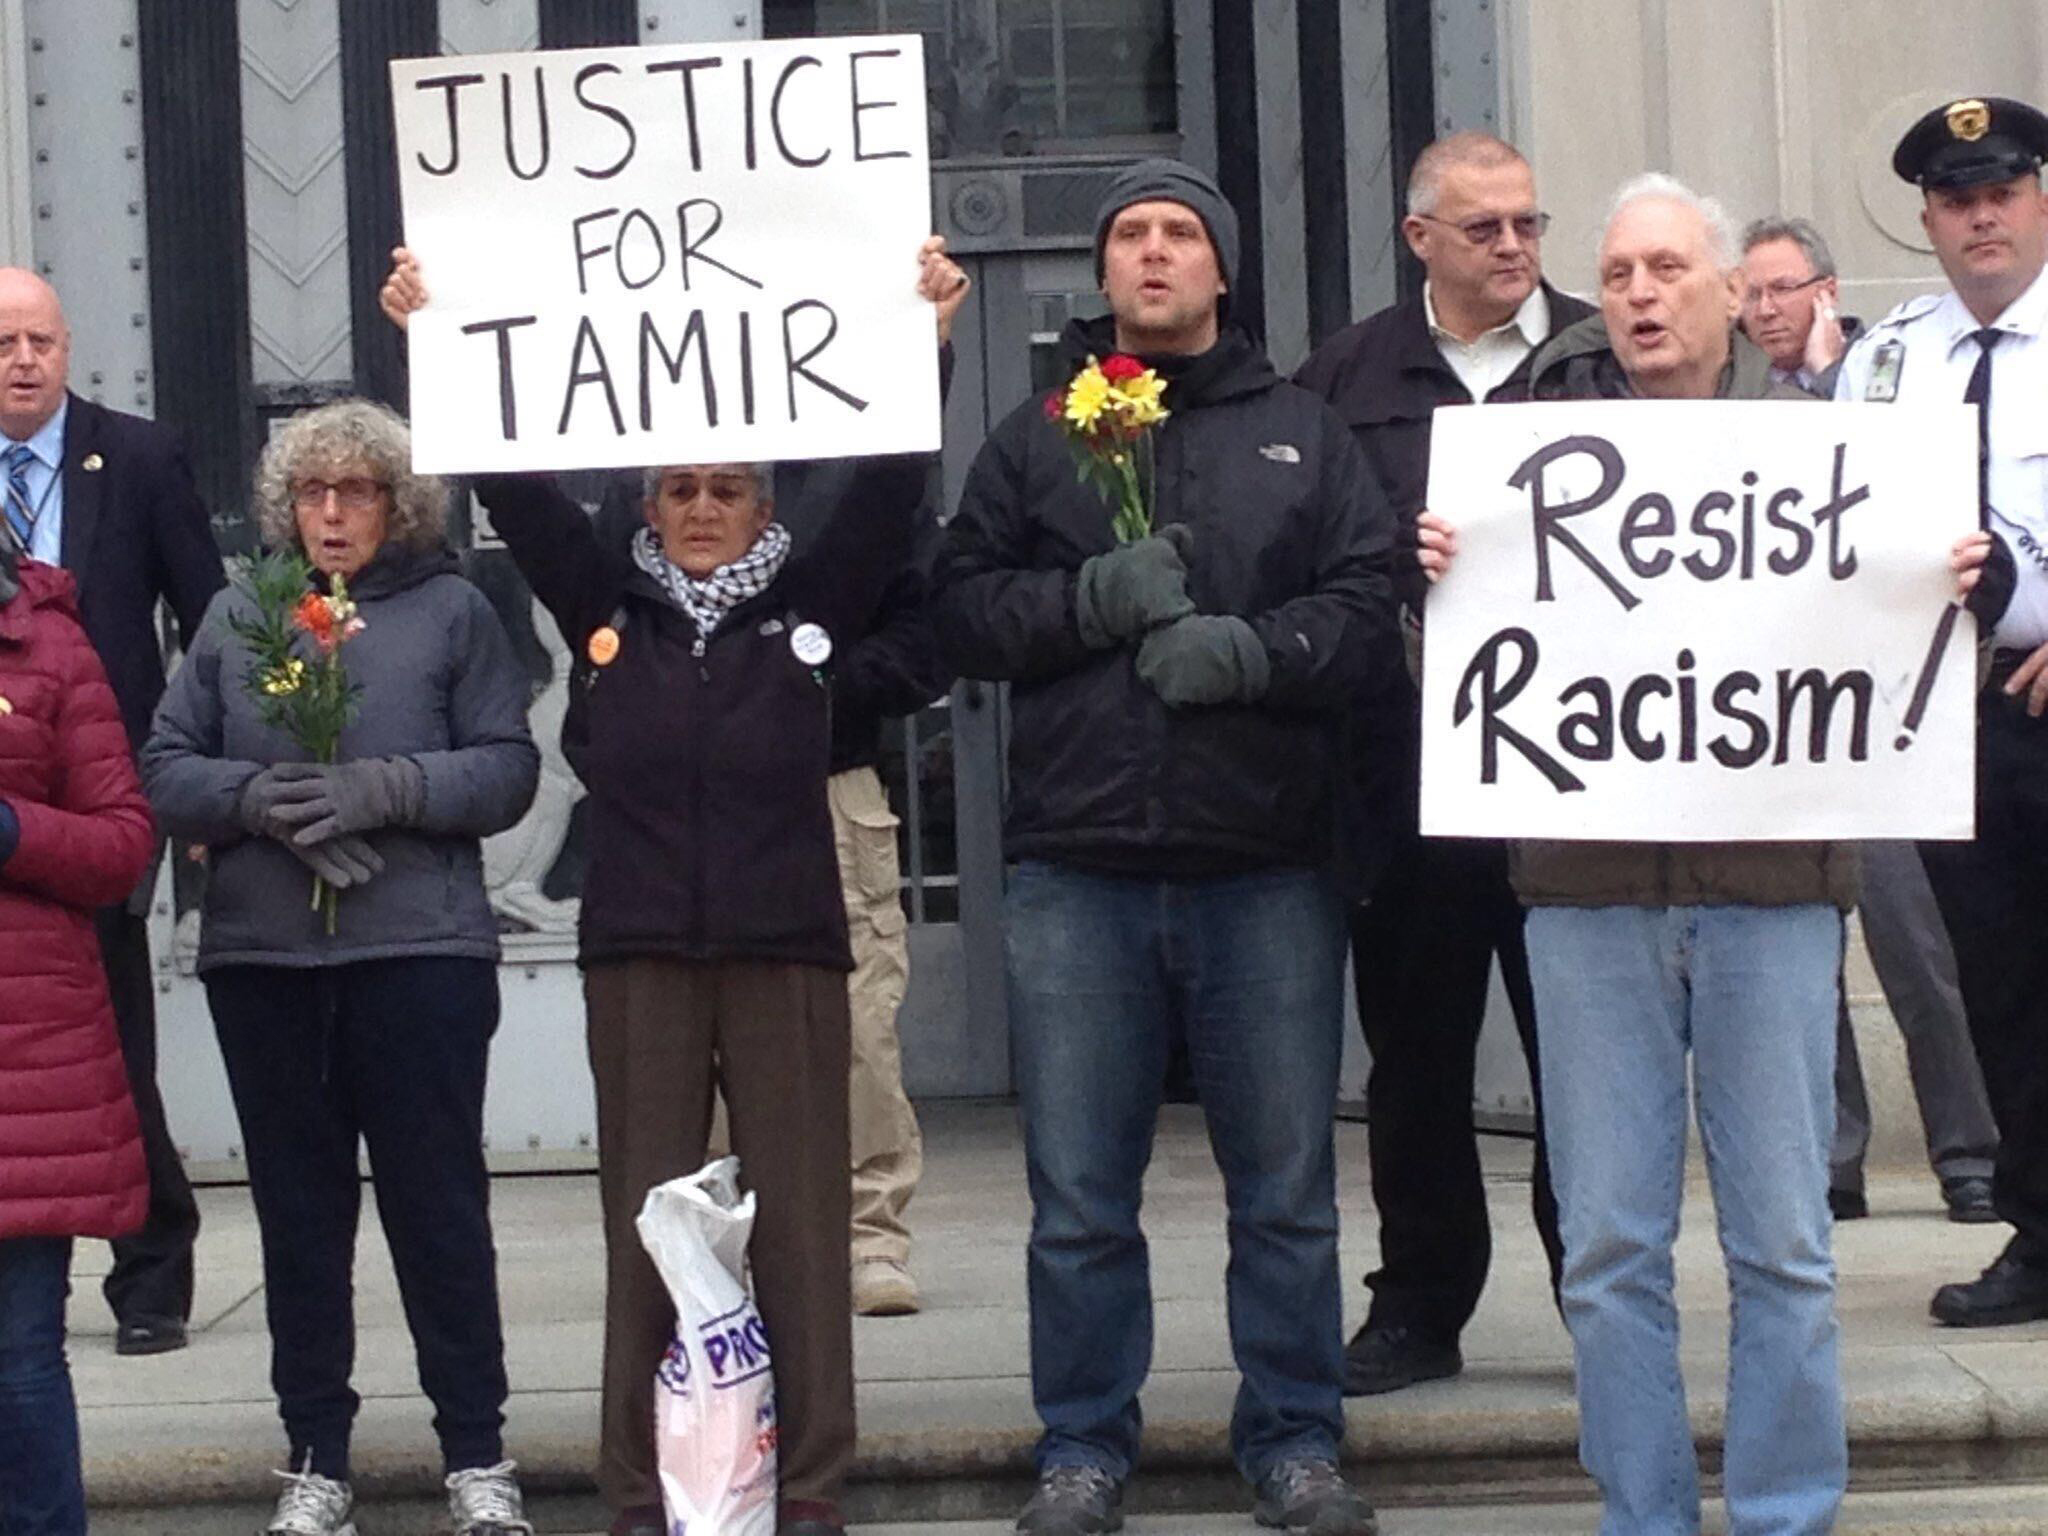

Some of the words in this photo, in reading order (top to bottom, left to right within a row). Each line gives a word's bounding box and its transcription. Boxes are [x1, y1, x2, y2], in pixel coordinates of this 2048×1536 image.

[415, 49, 910, 181] JUSTICE
[573, 198, 763, 294] FOR
[461, 299, 869, 441] TAMIR
[1506, 435, 1871, 612] Resist
[1452, 601, 1962, 794] Racism!
